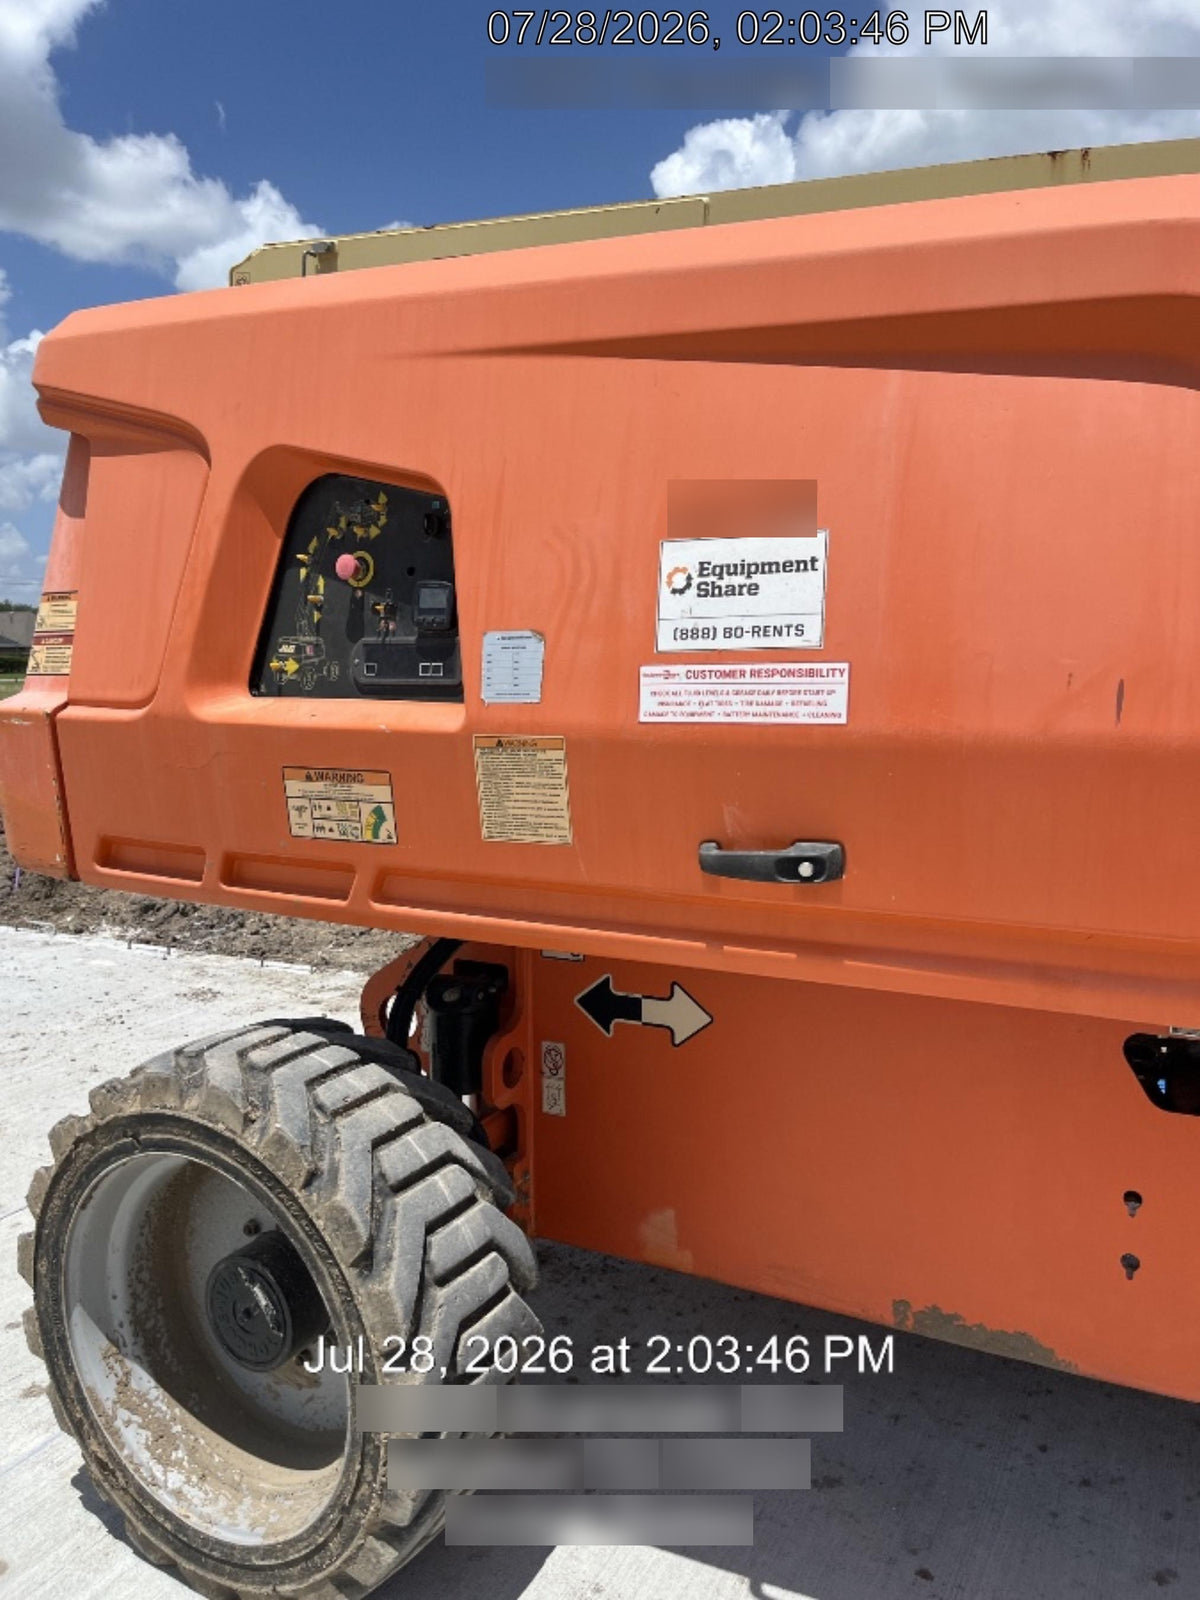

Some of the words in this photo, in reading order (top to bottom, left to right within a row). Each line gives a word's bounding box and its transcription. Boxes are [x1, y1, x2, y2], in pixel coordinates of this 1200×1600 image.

[697, 556, 819, 580] Equipment
[696, 581, 760, 598] Share
[673, 626, 717, 641] (888)
[685, 669, 746, 680] CUSTOMER
[750, 668, 846, 678] RESPONSIBILITY
[314, 771, 364, 784] WARNING
